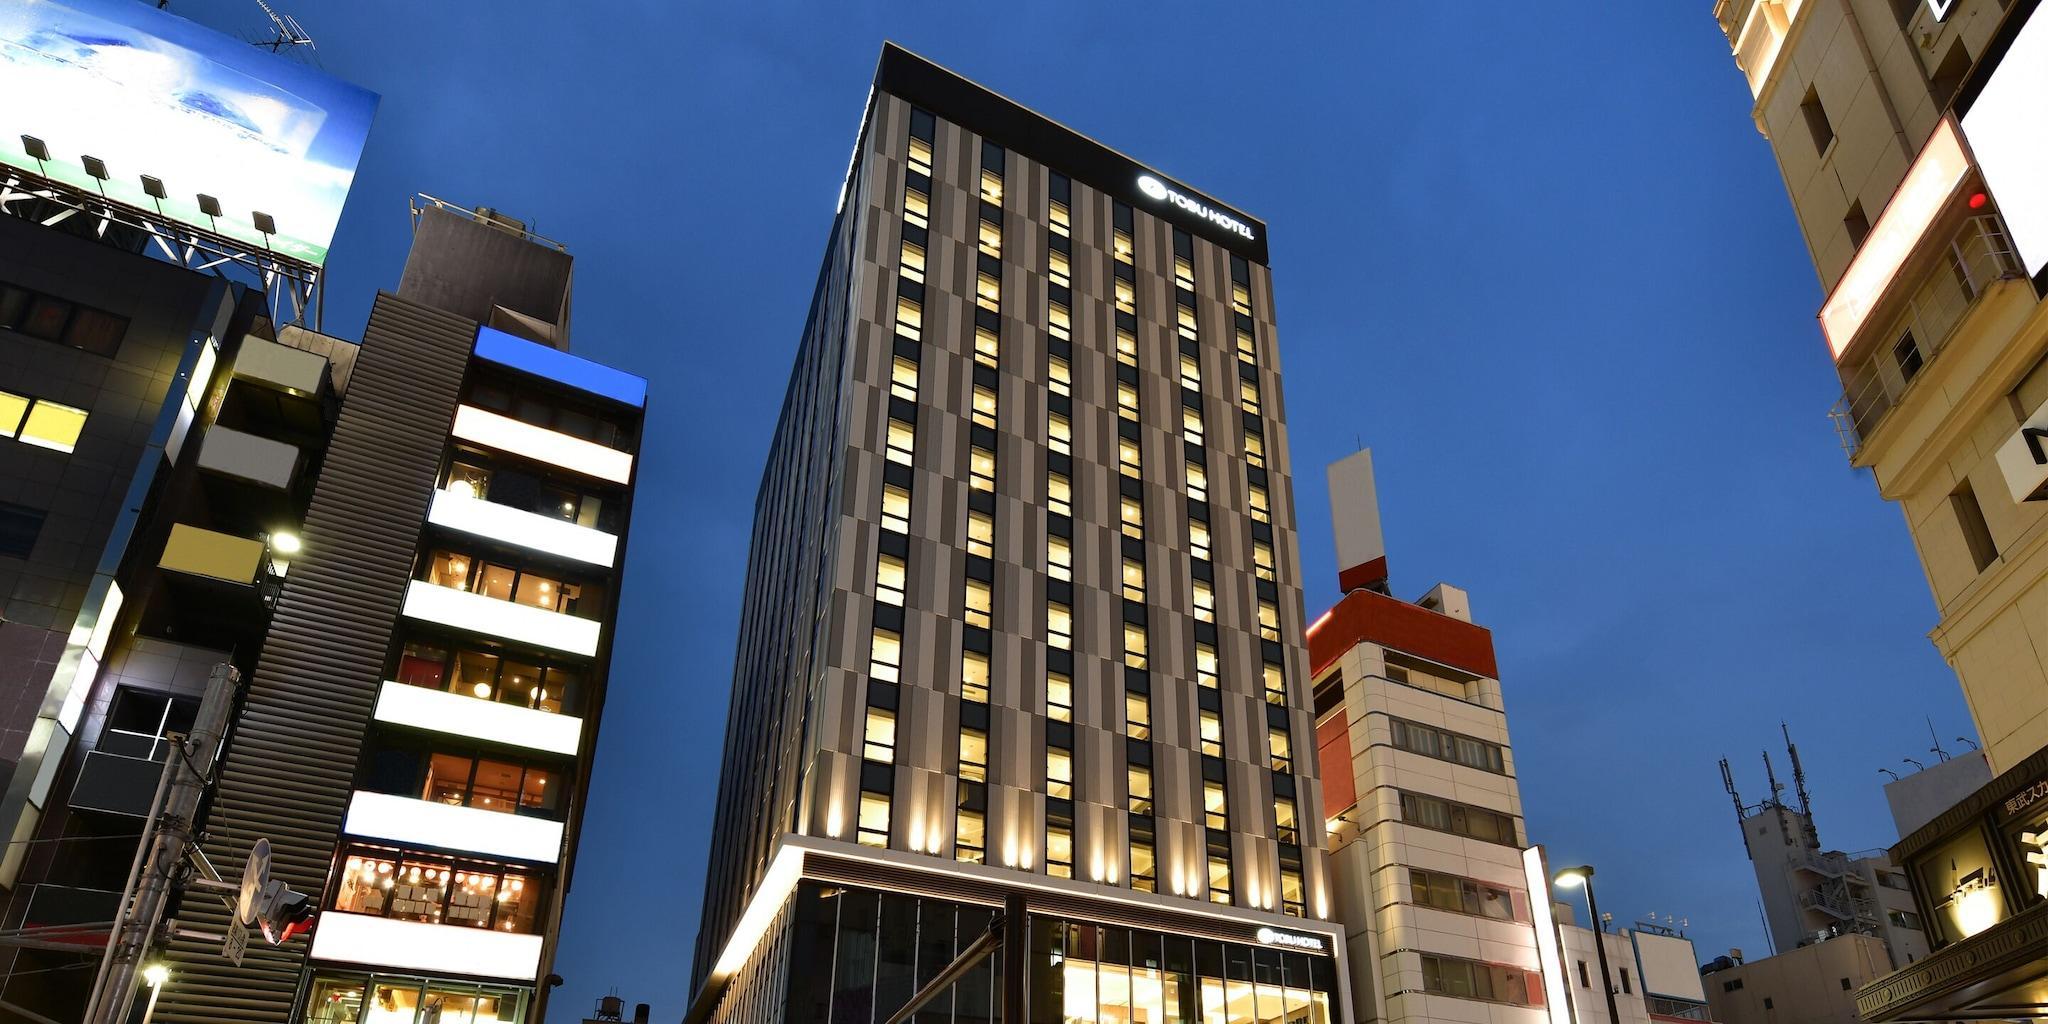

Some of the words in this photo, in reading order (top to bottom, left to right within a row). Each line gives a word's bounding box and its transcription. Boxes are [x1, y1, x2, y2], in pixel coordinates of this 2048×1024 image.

[1167, 189, 1208, 218] TOBU
[1208, 209, 1255, 240] HOTEL
[1296, 935, 1323, 949] HOTEL
